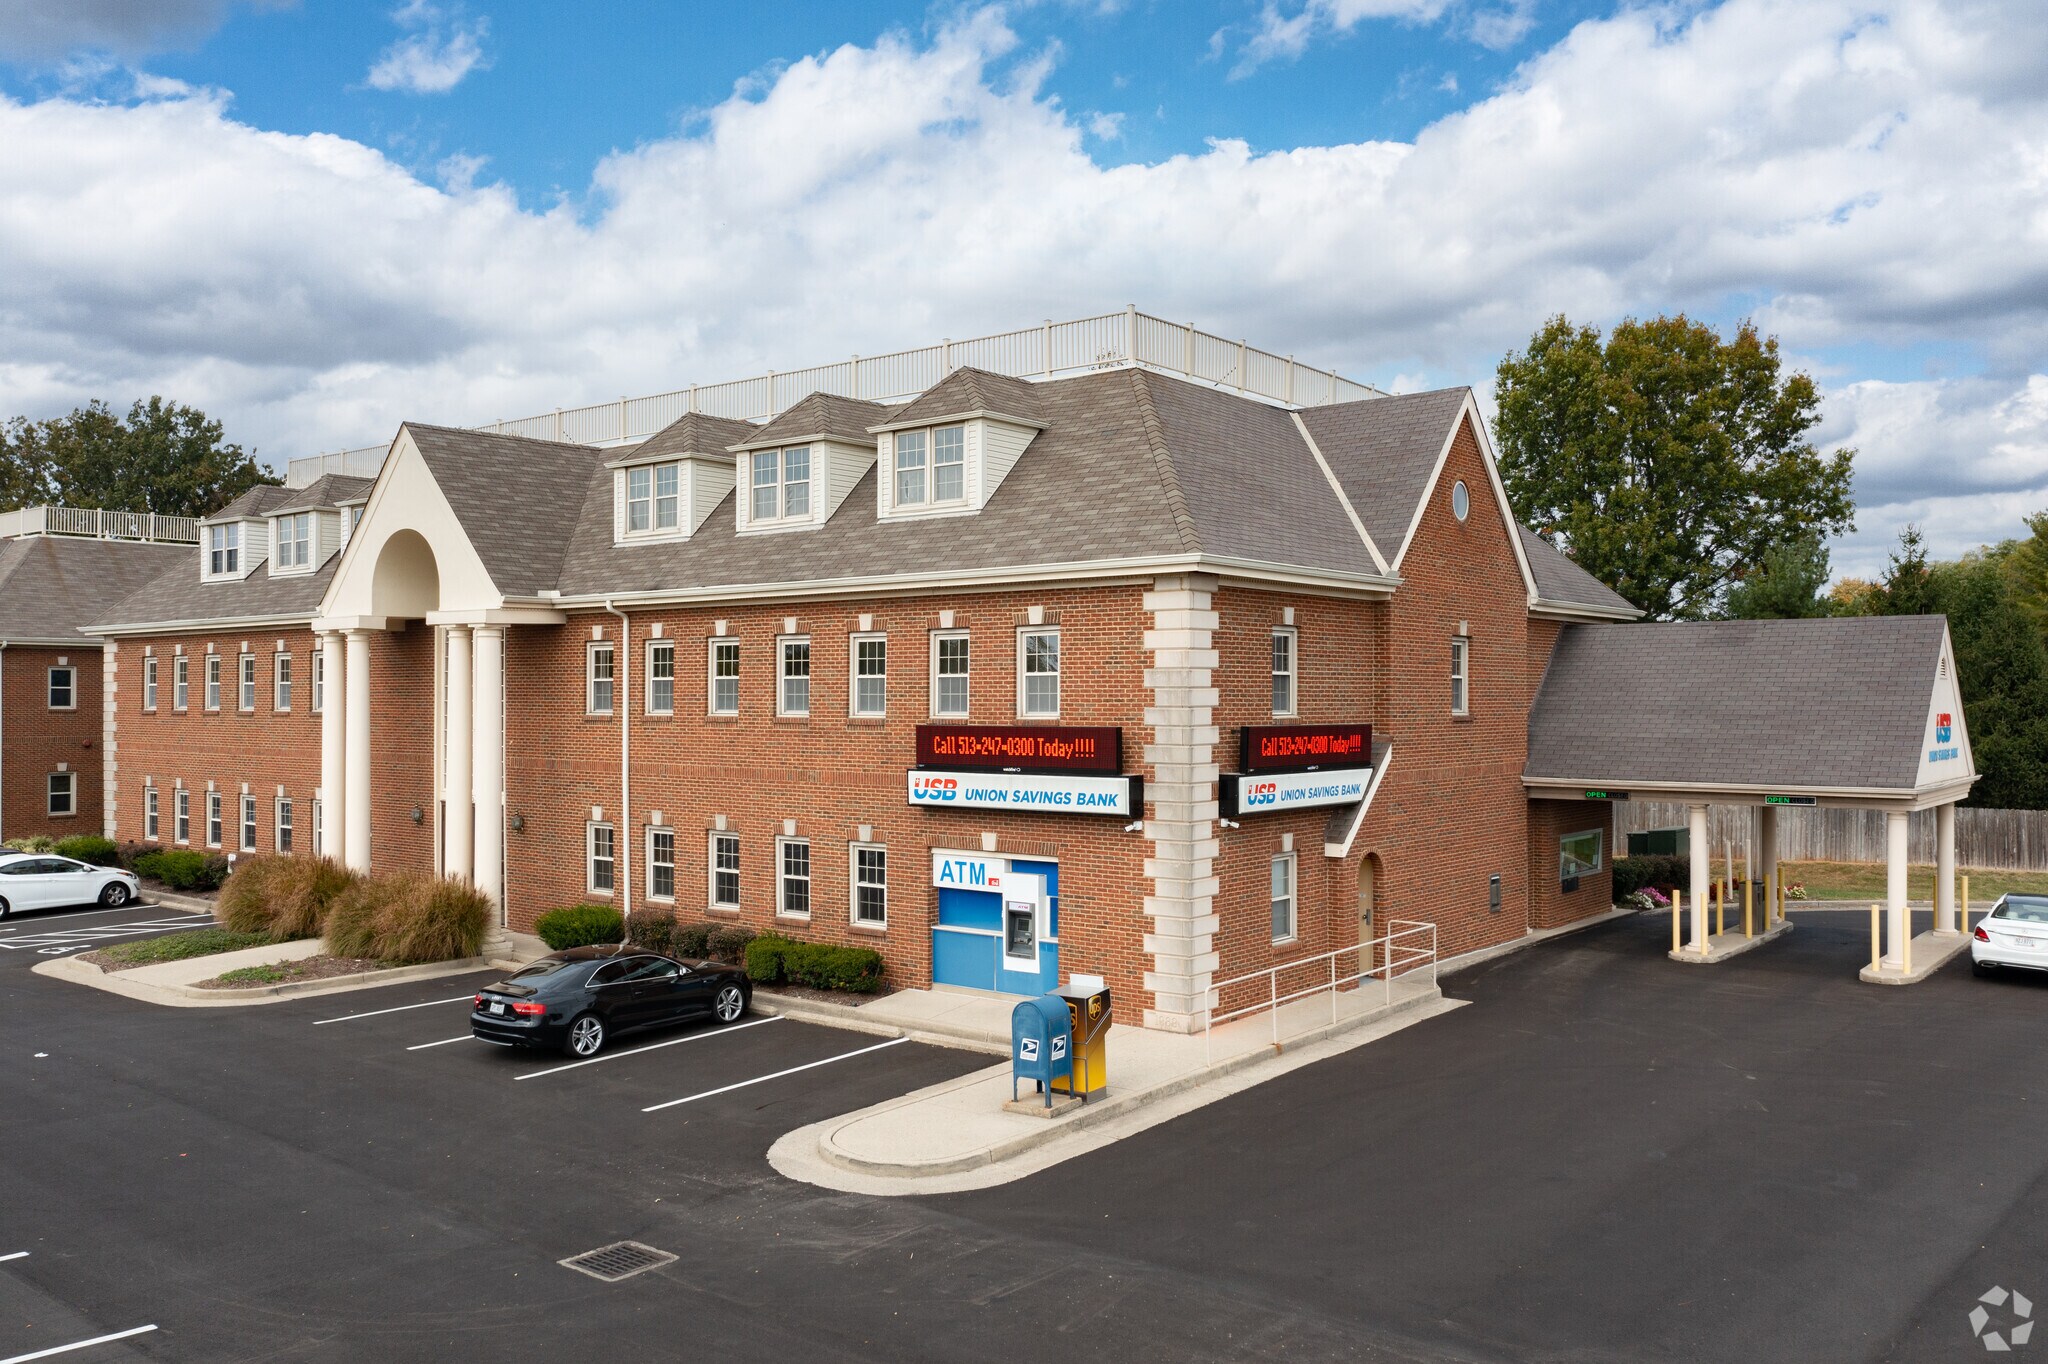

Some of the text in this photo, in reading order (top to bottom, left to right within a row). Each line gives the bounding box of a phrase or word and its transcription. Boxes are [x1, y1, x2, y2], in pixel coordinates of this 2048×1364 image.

[933, 736, 956, 754] Call
[958, 736, 1035, 756] 513-247-0300
[1261, 737, 1278, 757] Call
[1279, 736, 1327, 756] 513-247-0300
[913, 777, 1119, 807] USB UNION SAVINGS BANK
[1248, 783, 1361, 805] USB UNION SAVINGS BANK
[940, 860, 986, 886] ATM
[1090, 1002, 1101, 1017] ups
